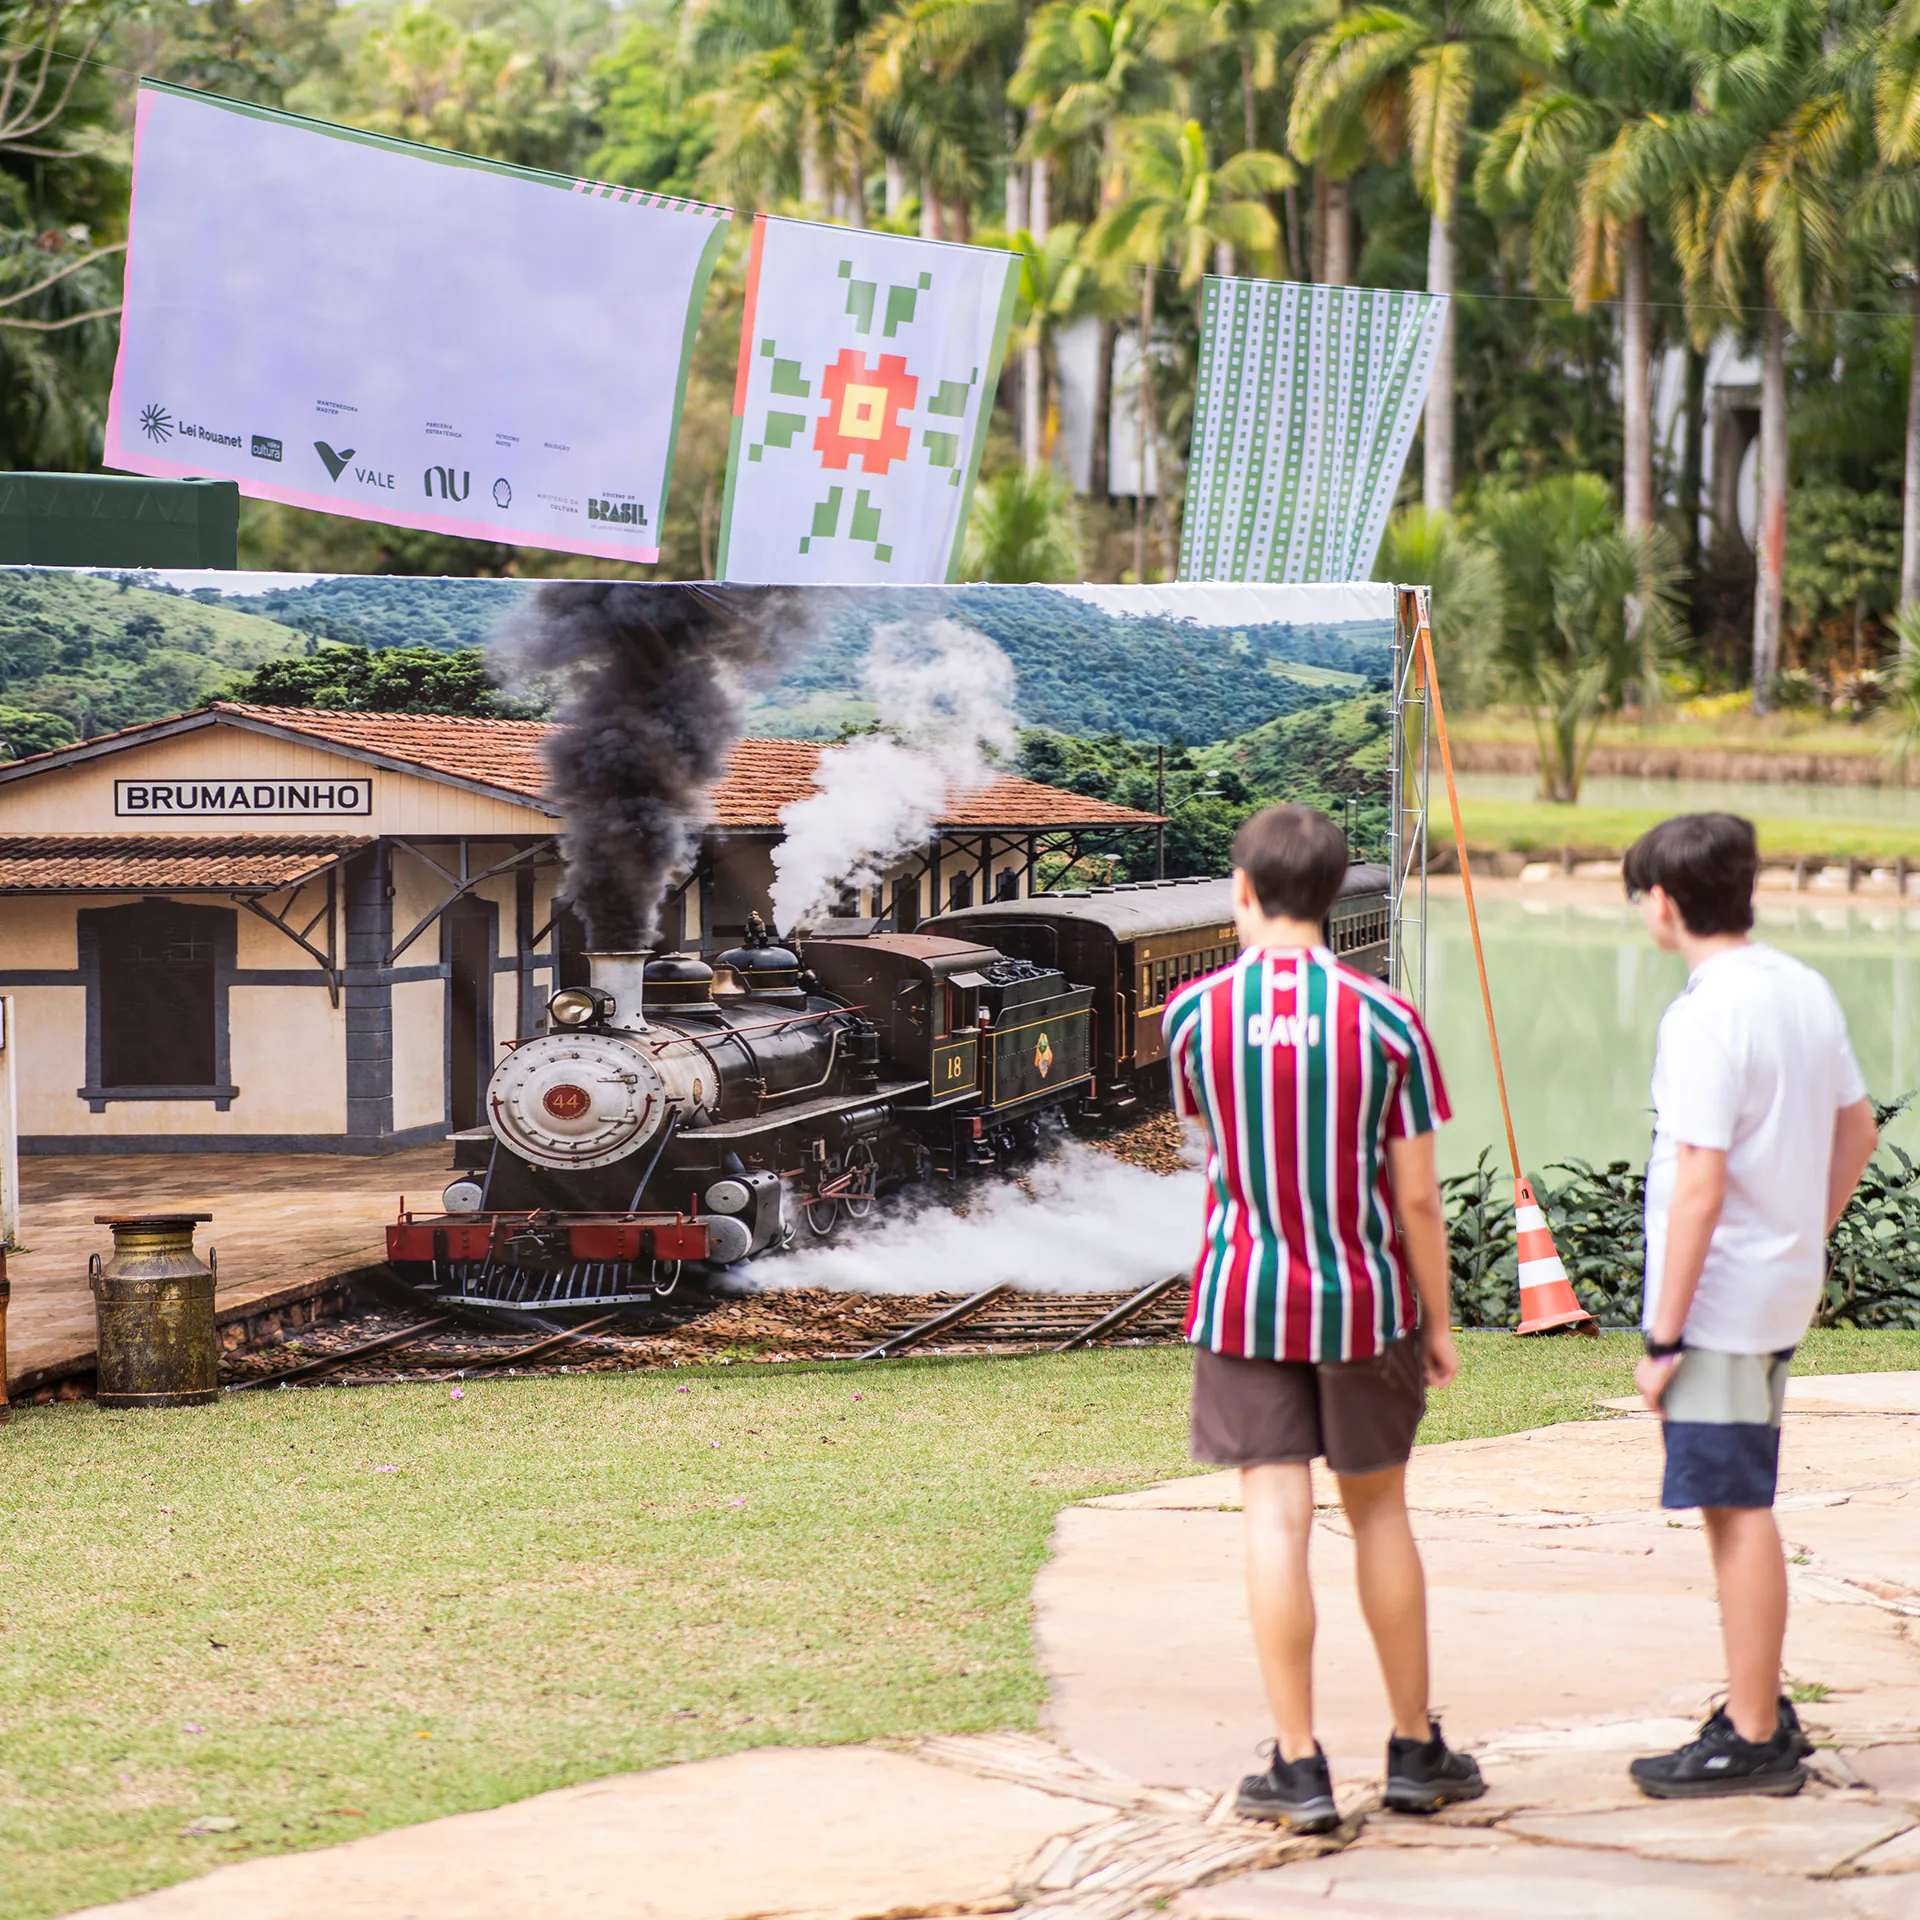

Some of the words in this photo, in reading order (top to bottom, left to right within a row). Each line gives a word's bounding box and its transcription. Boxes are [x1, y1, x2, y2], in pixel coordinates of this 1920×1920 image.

[179, 421, 197, 437] Lei
[199, 426, 242, 448] Rouanet
[355, 467, 395, 489] VALE
[588, 498, 648, 526] BRASIL
[126, 785, 359, 809] BRUMADINHO
[1247, 1013, 1320, 1047] DAVI
[947, 1056, 962, 1079] 18
[552, 1093, 579, 1109] 44
